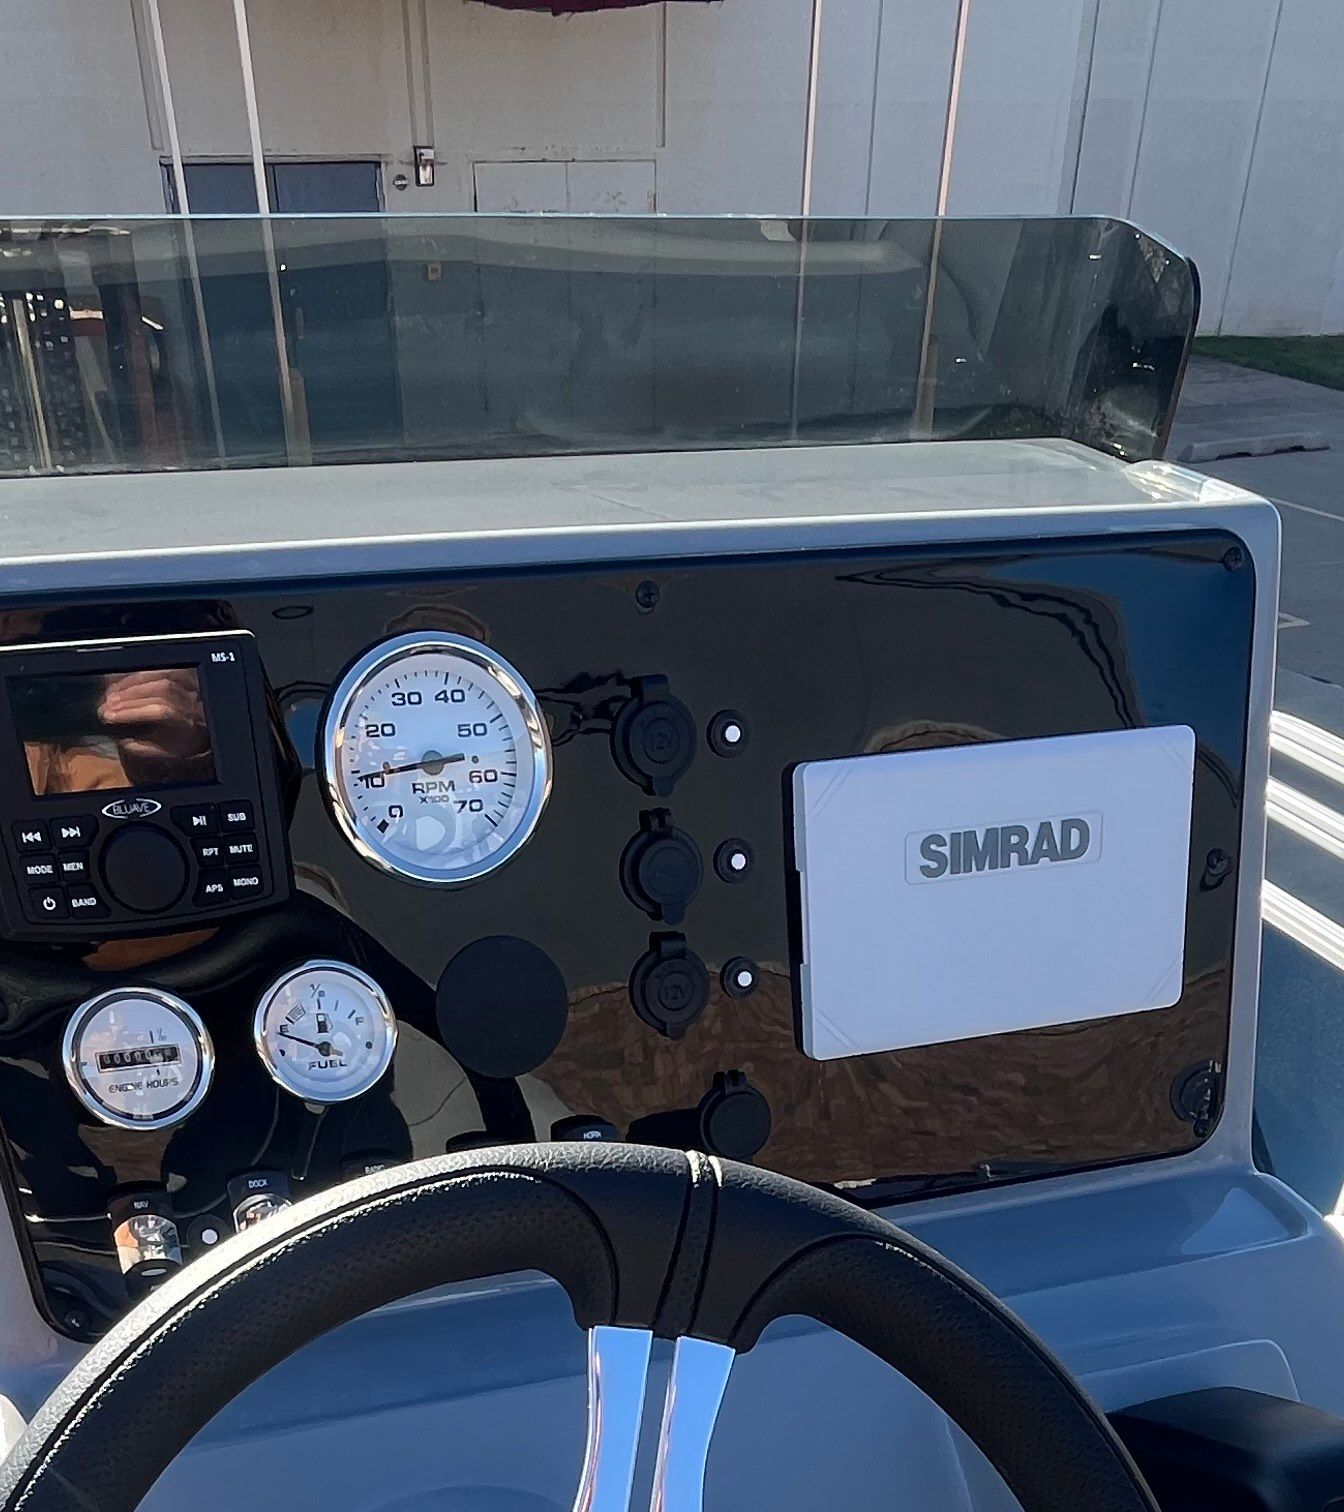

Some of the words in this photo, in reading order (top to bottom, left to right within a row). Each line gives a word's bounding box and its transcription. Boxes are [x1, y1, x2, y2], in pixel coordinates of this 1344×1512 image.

[391, 691, 423, 707] 30
[434, 689, 466, 704] 40
[365, 723, 396, 738] 20
[457, 722, 488, 738] 50
[468, 769, 498, 784] 60
[412, 780, 456, 795] RPM
[456, 799, 484, 814] 70
[227, 812, 246, 822] SUB
[229, 844, 253, 855] MUTE
[919, 818, 1090, 879] SIMRAD
[27, 864, 54, 875] MODE
[71, 897, 97, 908] BAND
[355, 1017, 364, 1025] F
[308, 1059, 347, 1070] FUEL
[146, 1077, 179, 1089] HOURS
[248, 1179, 268, 1188] DOCK
